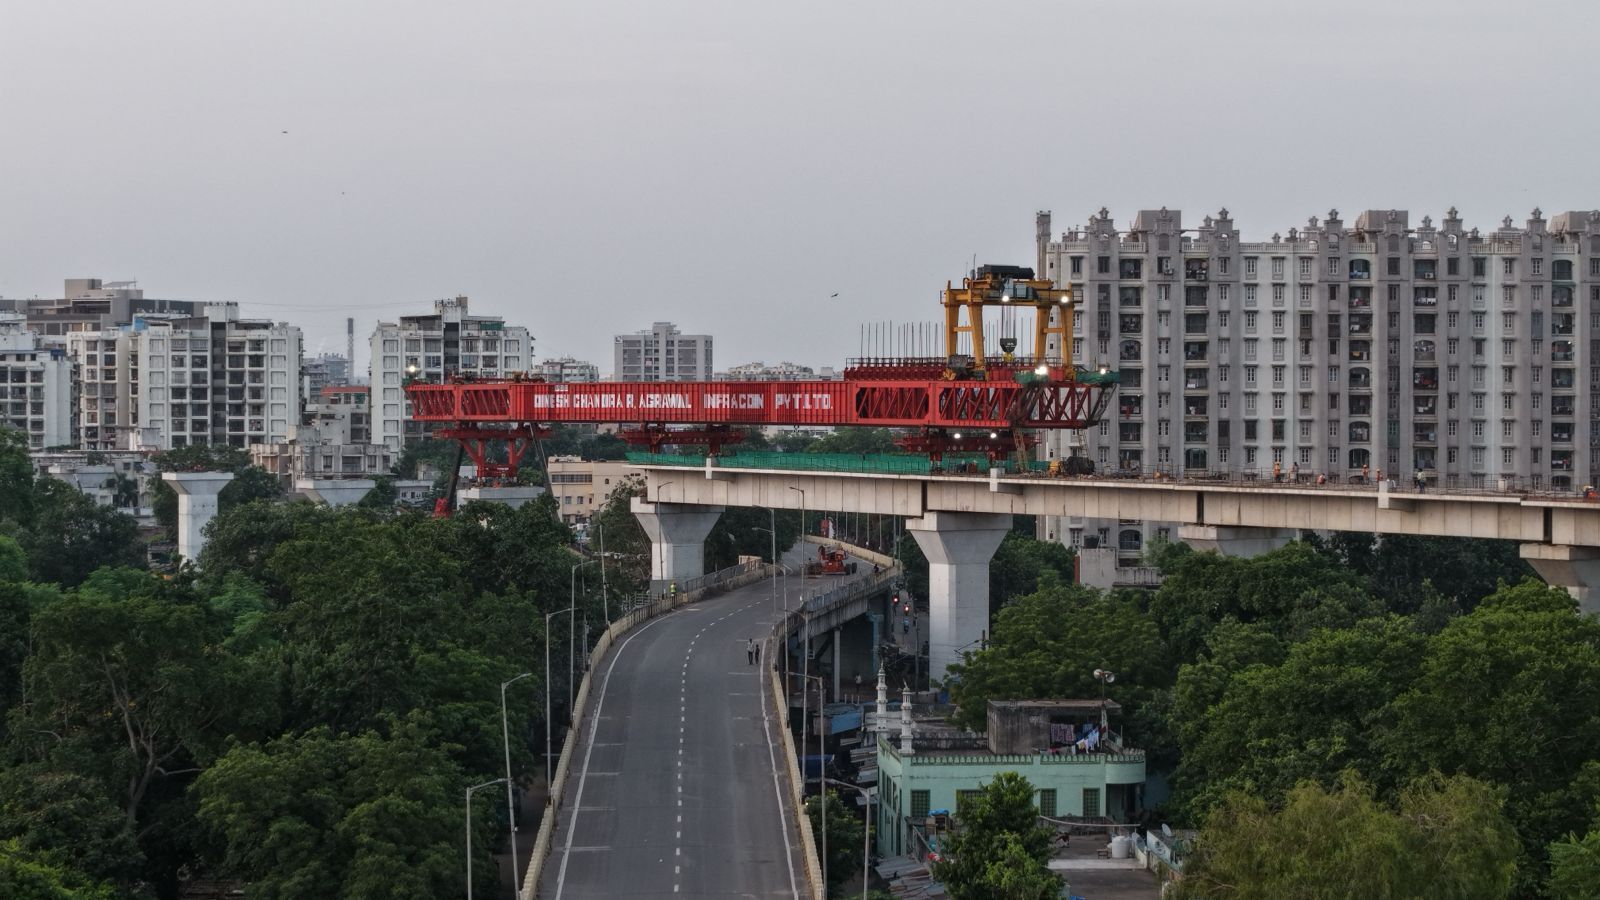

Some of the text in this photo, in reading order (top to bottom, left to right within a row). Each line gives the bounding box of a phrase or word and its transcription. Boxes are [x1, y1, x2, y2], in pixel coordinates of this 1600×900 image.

[534, 394, 569, 409] DINESH
[573, 394, 623, 409] CHANDRA
[639, 394, 692, 409] AGRAWAL
[704, 394, 764, 409] INFRACON
